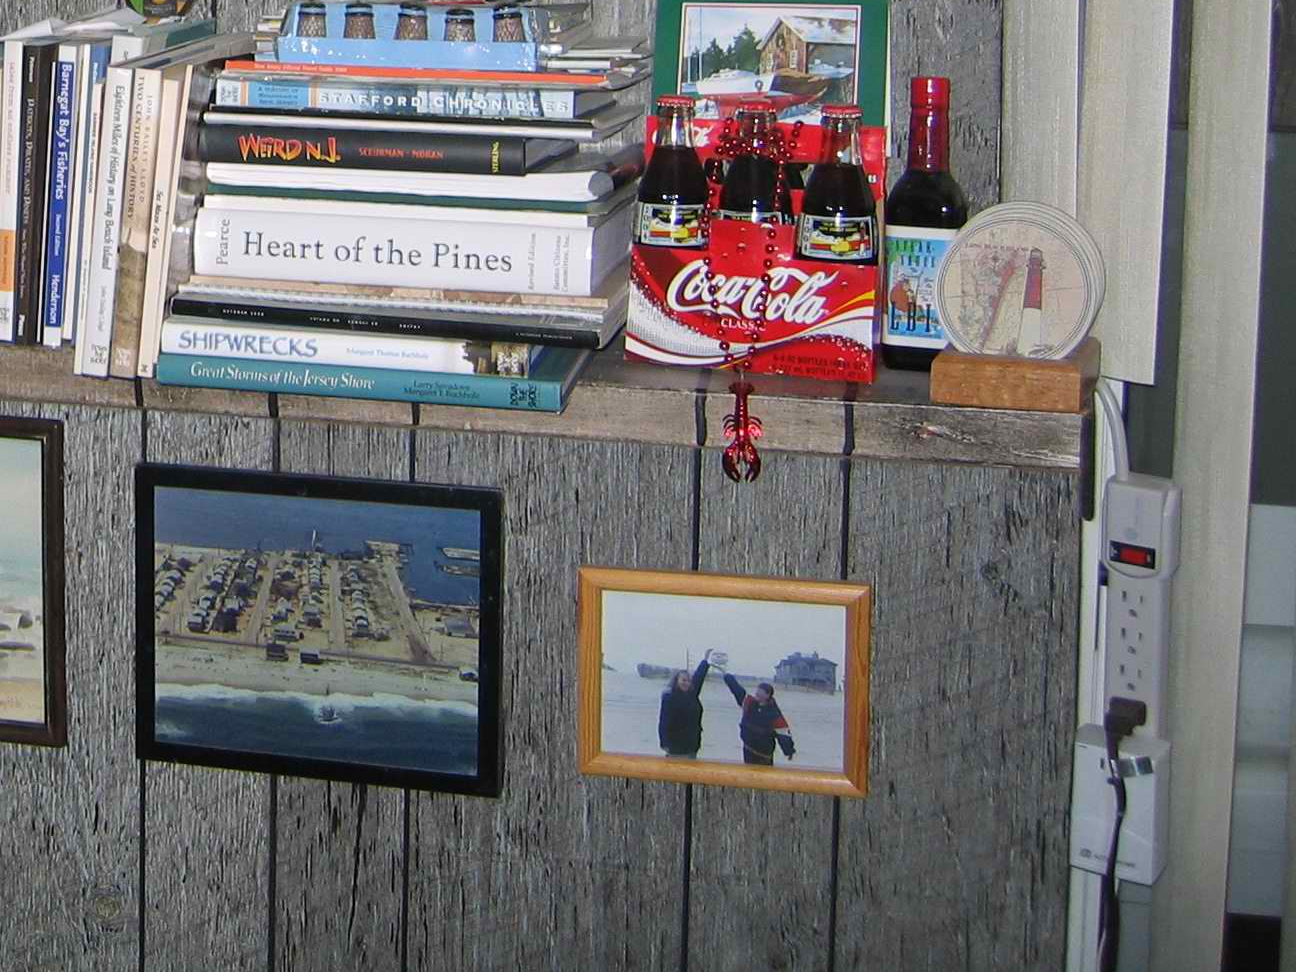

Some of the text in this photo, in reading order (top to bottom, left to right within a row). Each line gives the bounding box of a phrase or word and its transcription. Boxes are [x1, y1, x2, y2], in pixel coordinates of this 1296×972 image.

[57, 63, 73, 116] Barnegat
[112, 85, 126, 123] Eighteen
[319, 93, 423, 108] STAFFORD
[431, 95, 570, 112] CHRONICLES
[55, 118, 71, 148] Bay's
[111, 123, 124, 145] Miles
[126, 75, 145, 220] TWO CENTURIES of HISTORY
[109, 146, 122, 155] of
[138, 94, 153, 204] JOHN BAILEY LLOYD
[54, 150, 69, 201] Fisheries
[107, 156, 120, 185] History
[103, 197, 117, 218] Long
[53, 235, 62, 257] Edition
[103, 219, 115, 244] Beach
[215, 218, 231, 266] Pearce
[101, 245, 113, 271] Island
[242, 230, 513, 273] Heart of the Pines
[48, 274, 61, 324] Henderson
[177, 329, 319, 358] SHIPWRECKS
[190, 361, 375, 391] Great Storms of the Jersey Shore
